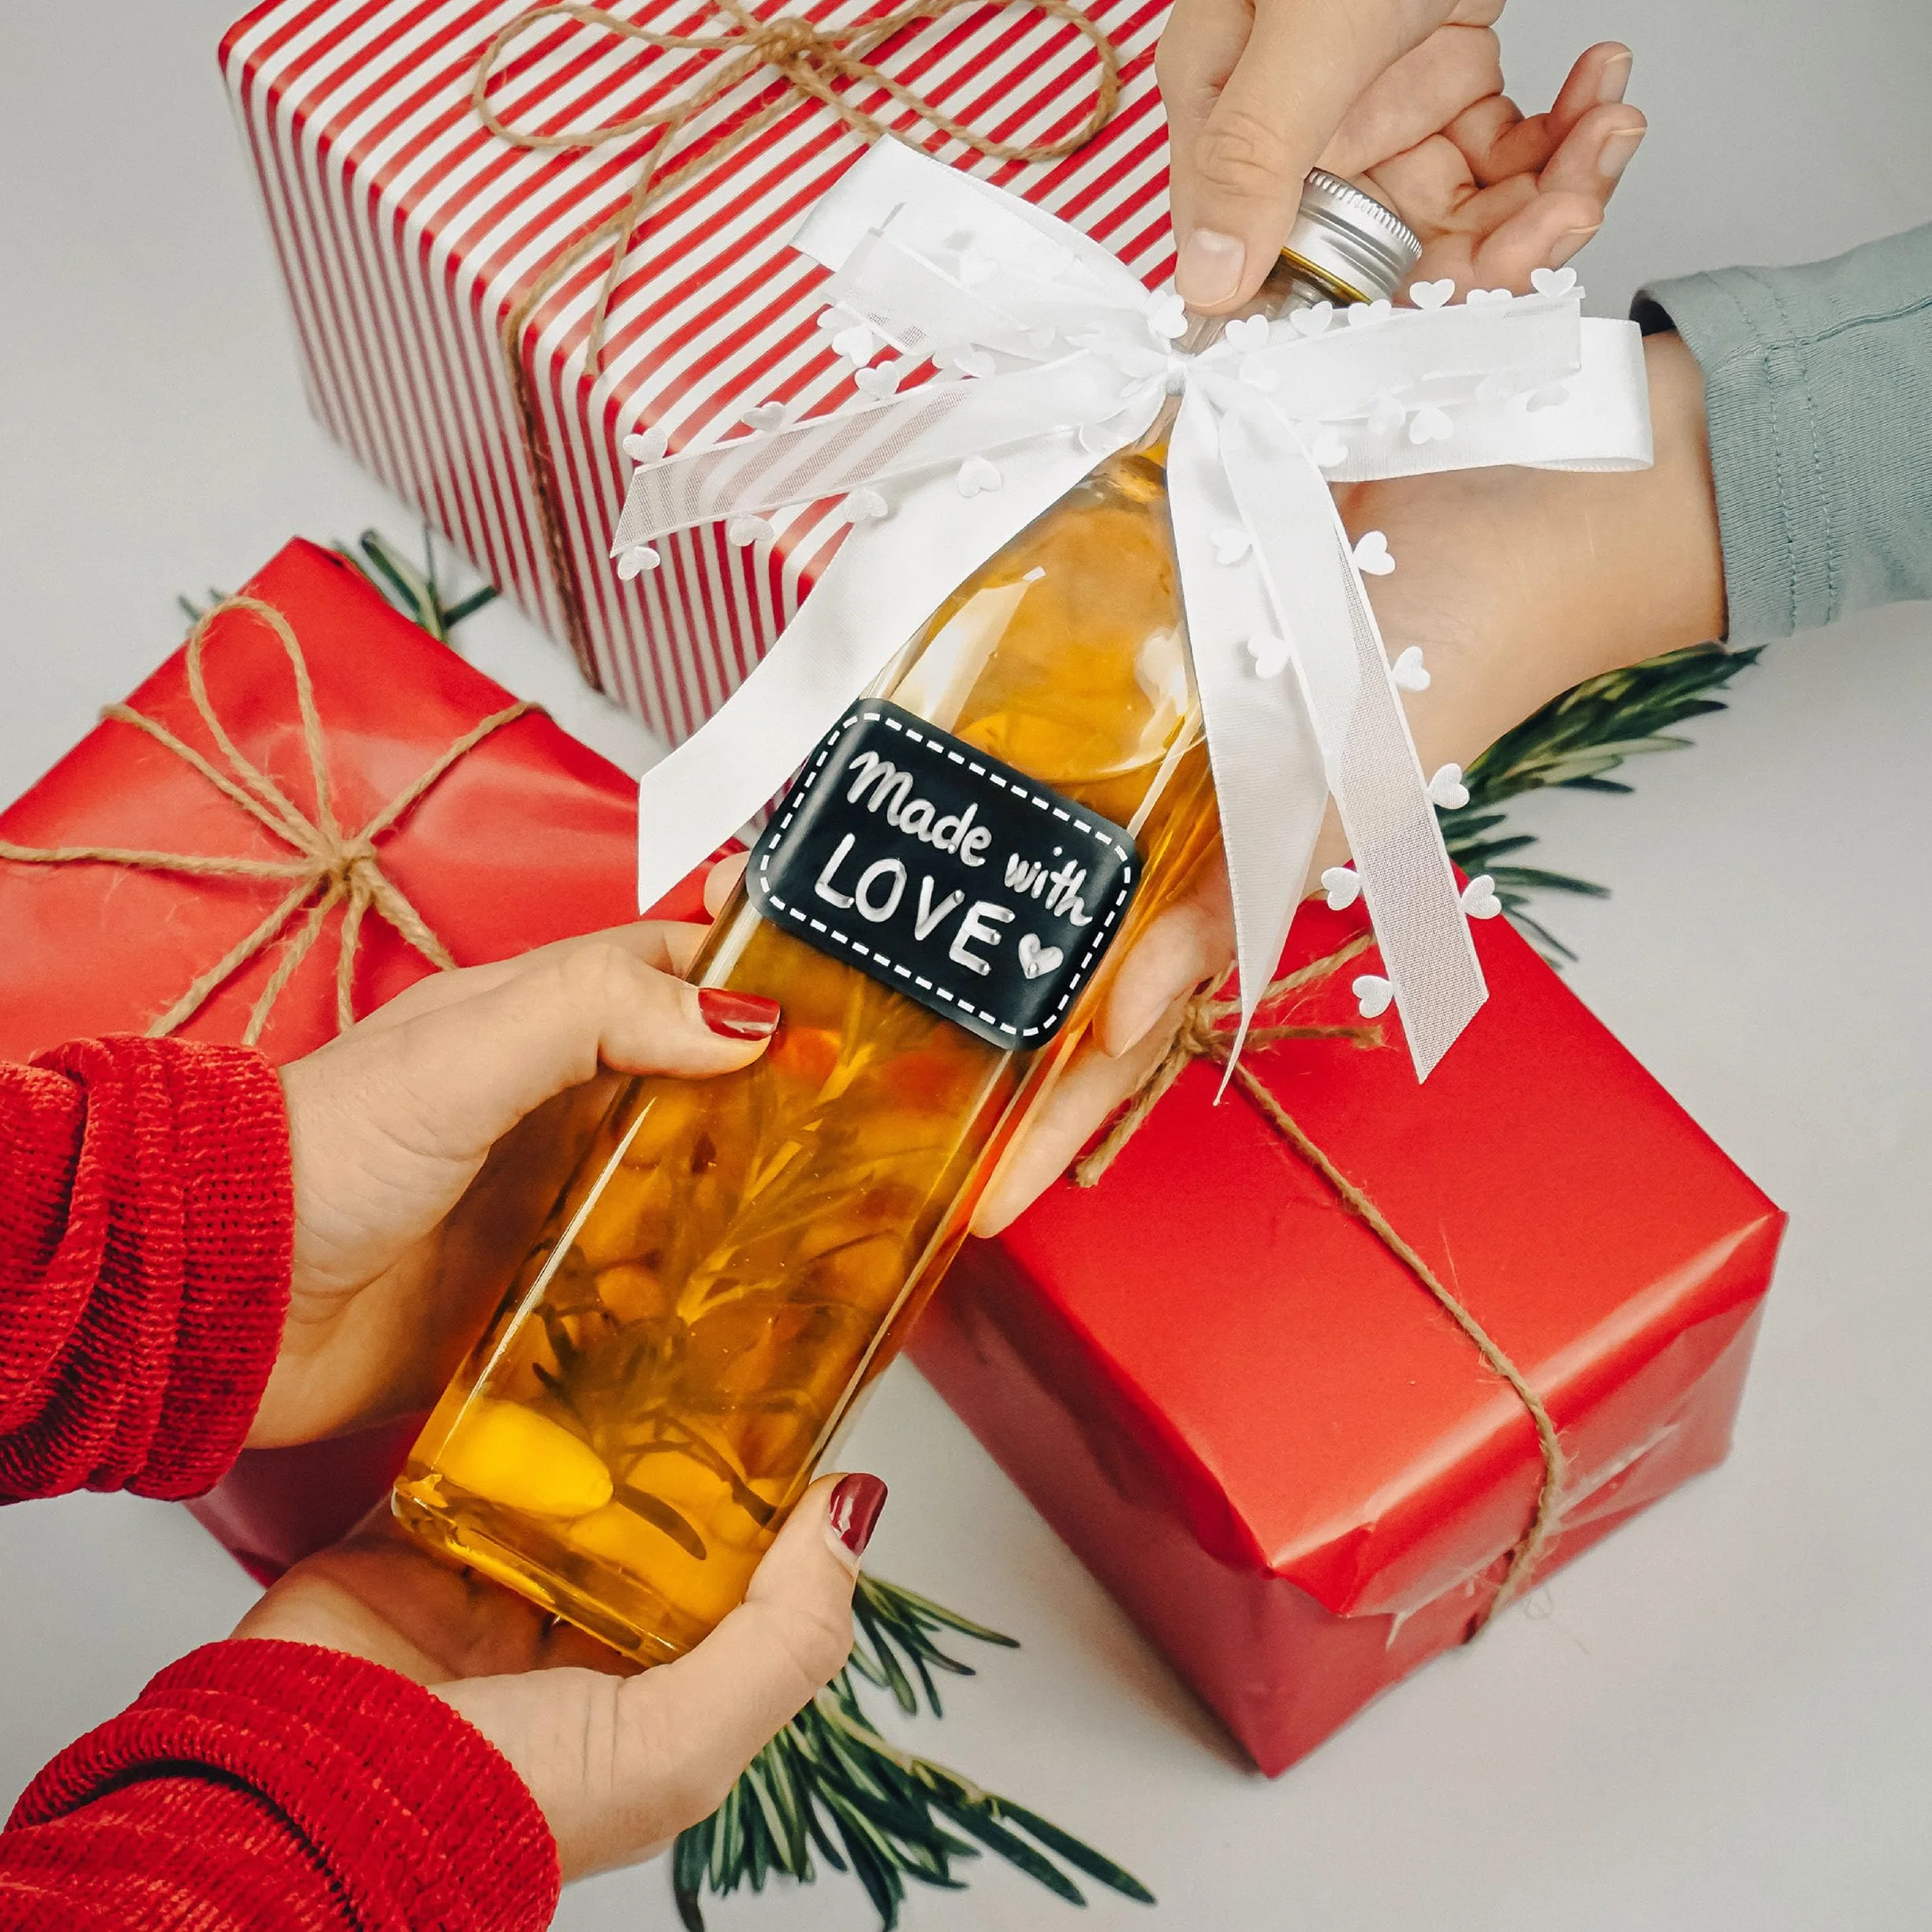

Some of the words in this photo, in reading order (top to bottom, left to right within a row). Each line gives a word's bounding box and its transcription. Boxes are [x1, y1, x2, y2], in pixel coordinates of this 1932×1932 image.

[814, 833, 1016, 976] LOVE
[847, 750, 993, 867] Made
[1003, 846, 1094, 927] with
